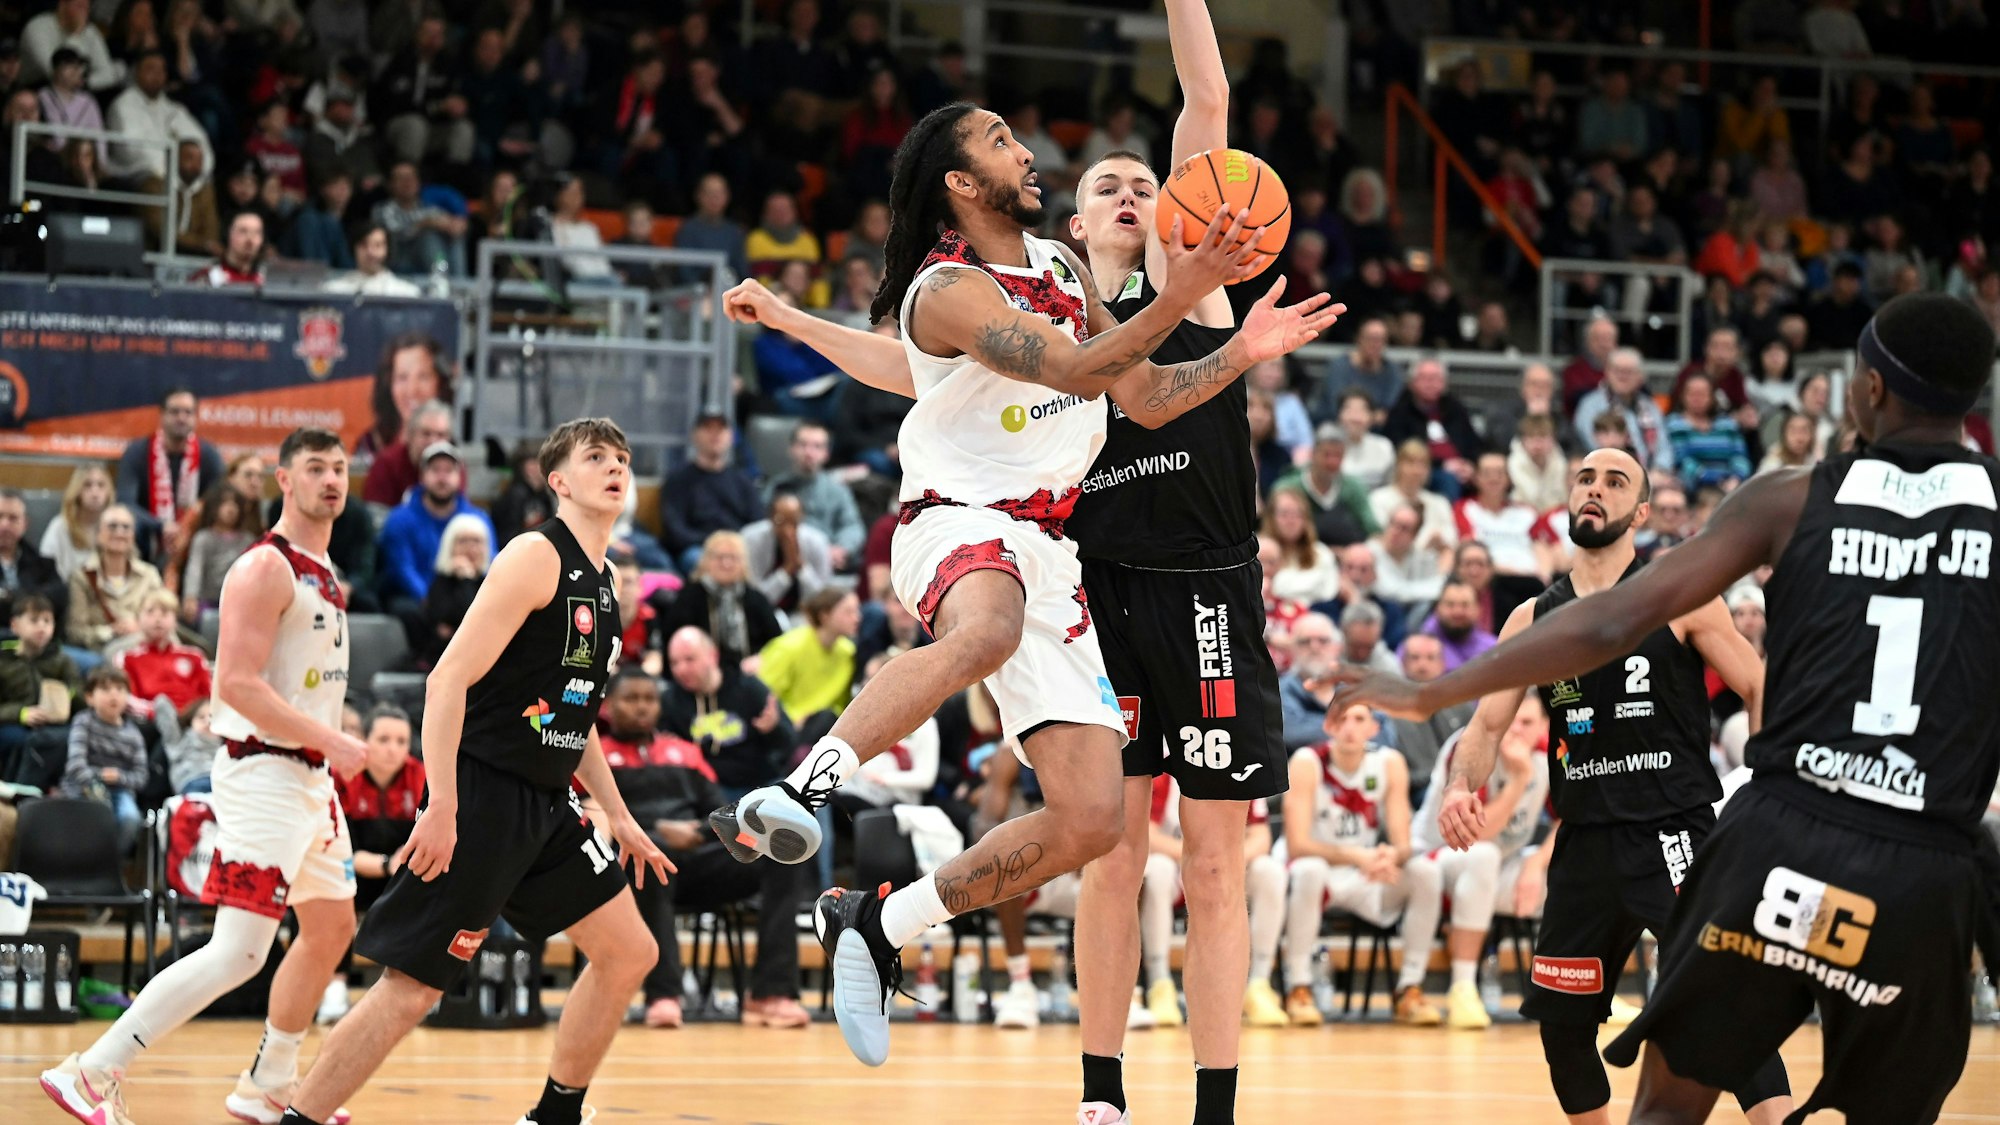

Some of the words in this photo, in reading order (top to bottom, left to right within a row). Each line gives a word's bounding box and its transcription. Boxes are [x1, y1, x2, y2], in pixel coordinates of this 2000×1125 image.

[1082, 450, 1190, 494] estfalenWIND
[1882, 470, 1954, 500] HESSE
[1828, 527, 1938, 582] HUNT
[1937, 528, 1993, 580] JR
[1193, 599, 1222, 679] FREY
[1217, 603, 1233, 677] NUTRITION
[1624, 655, 1651, 694] 2
[1852, 594, 1924, 736] 1
[541, 728, 588, 750] Westfale
[1179, 725, 1232, 770] 26
[1795, 743, 1926, 797] FOXWATCH
[1535, 961, 1560, 977] ROAD
[1560, 967, 1596, 980] HOUSE
